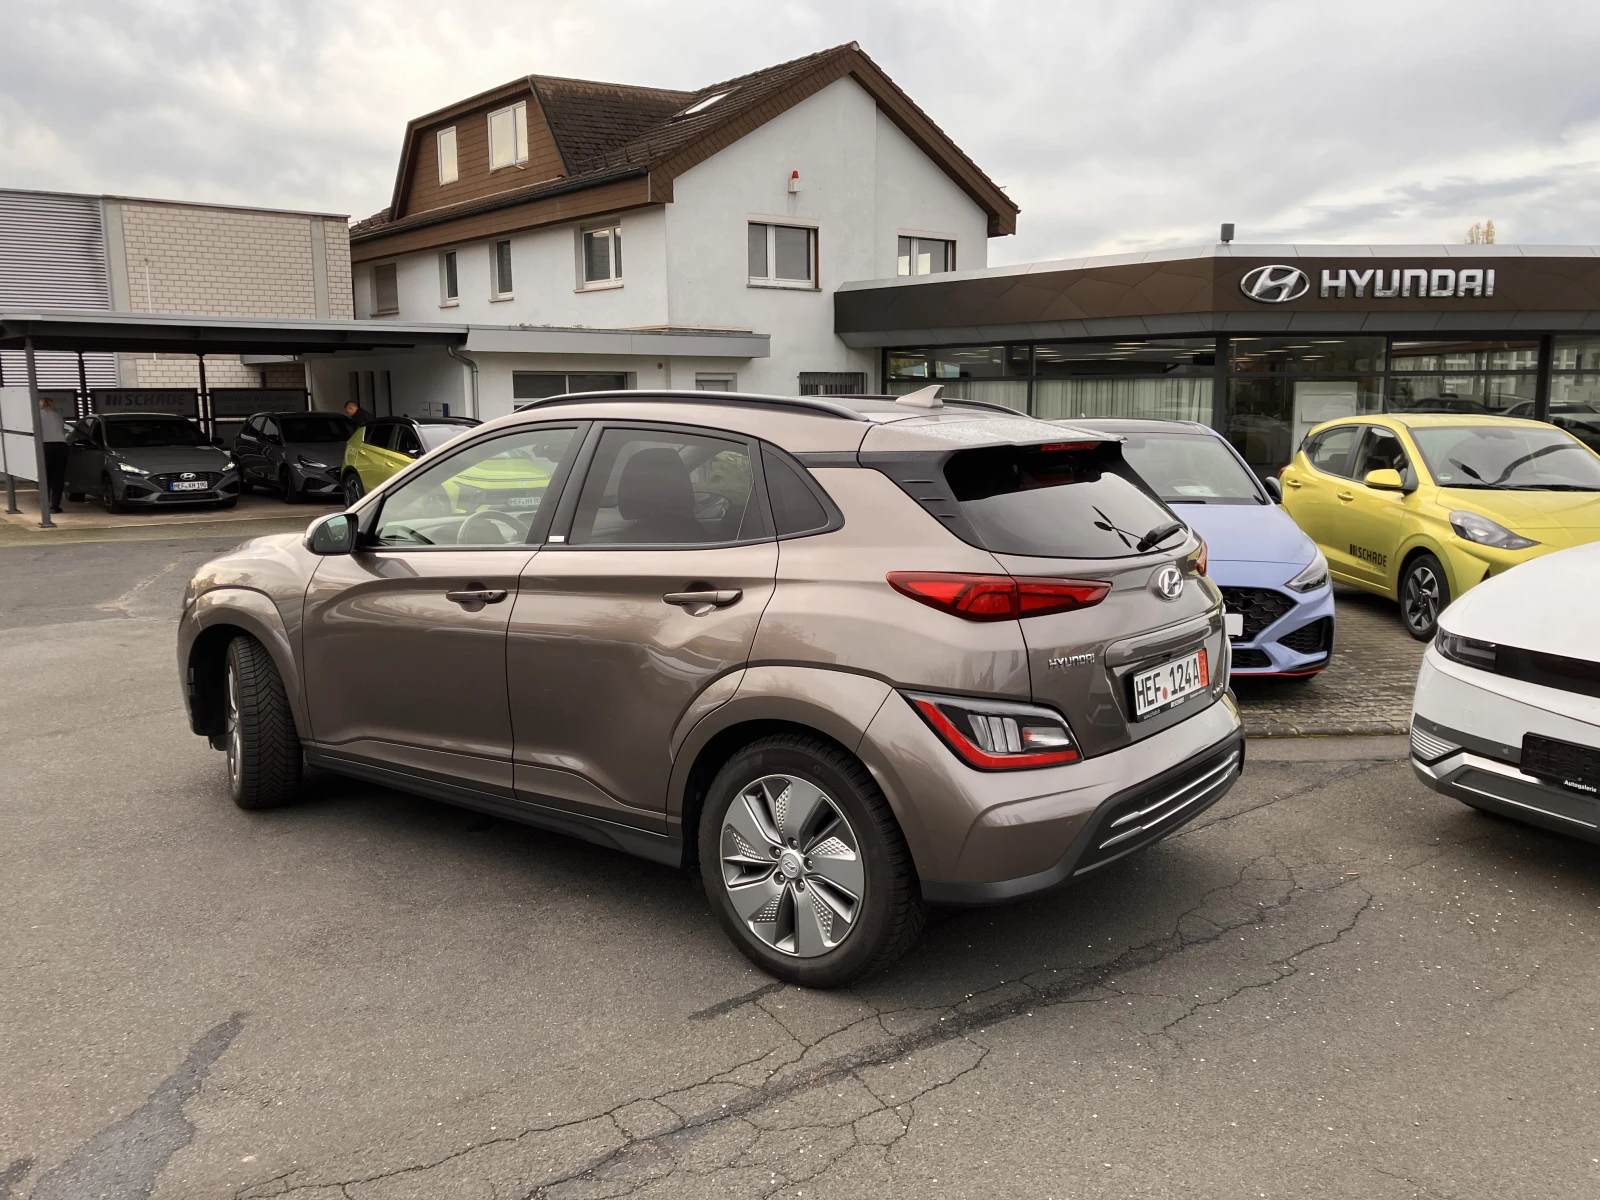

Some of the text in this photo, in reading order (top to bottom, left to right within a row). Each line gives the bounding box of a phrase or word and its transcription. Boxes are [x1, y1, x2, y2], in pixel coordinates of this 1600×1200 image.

[1320, 268, 1495, 298] HYUNDAI
[125, 393, 185, 406] SCHADE
[1358, 546, 1387, 567] SCHADE
[1049, 653, 1095, 669] HYUNDAI
[1136, 672, 1161, 711] HEF
[1564, 779, 1597, 793] Autogalerie
